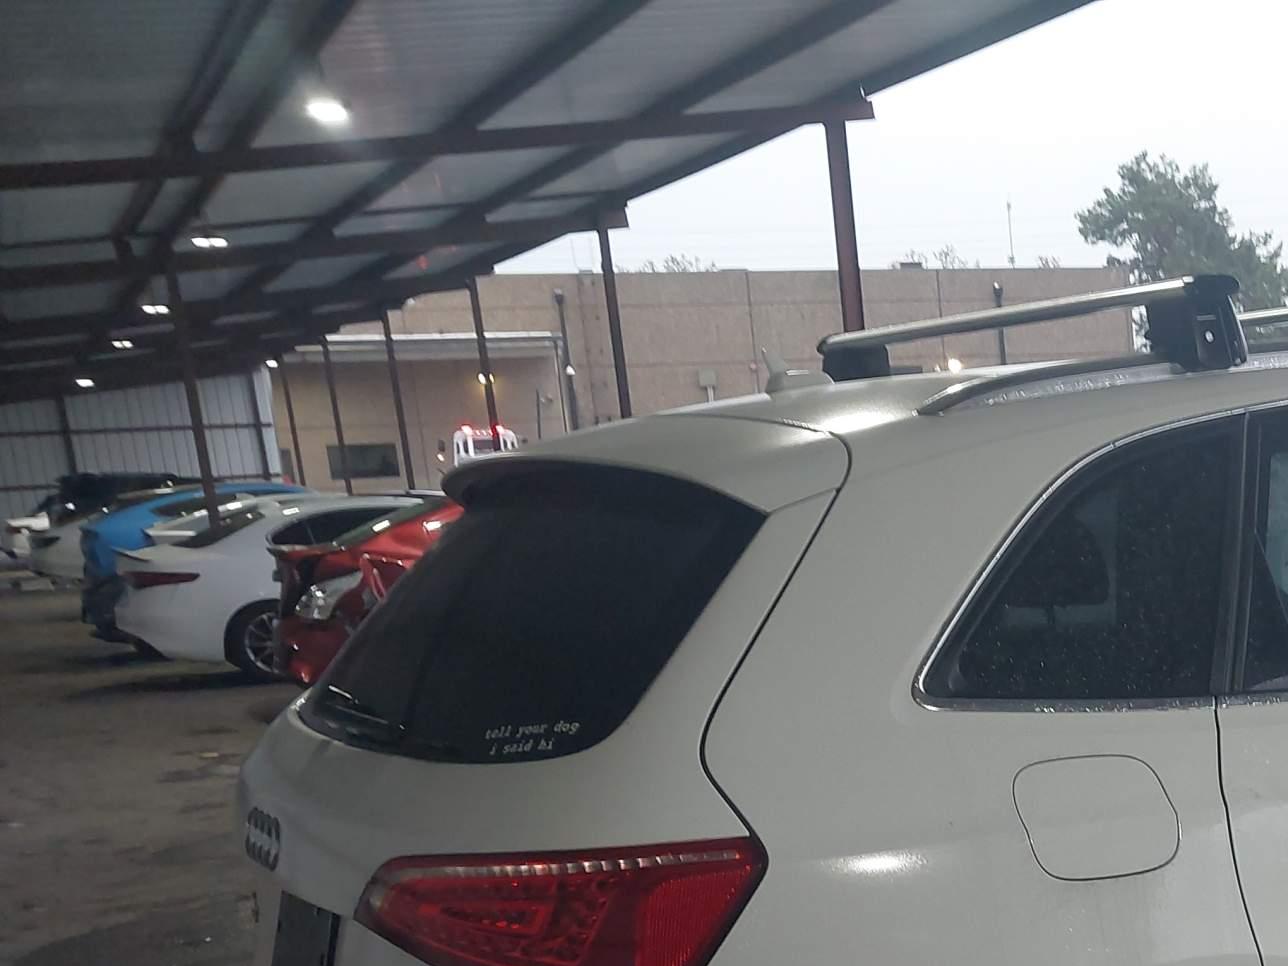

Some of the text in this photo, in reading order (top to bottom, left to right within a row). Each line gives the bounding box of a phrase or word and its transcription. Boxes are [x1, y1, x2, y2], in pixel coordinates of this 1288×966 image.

[485, 720, 581, 740] tell your dog
[502, 739, 534, 754] said
[537, 737, 555, 751] hi
